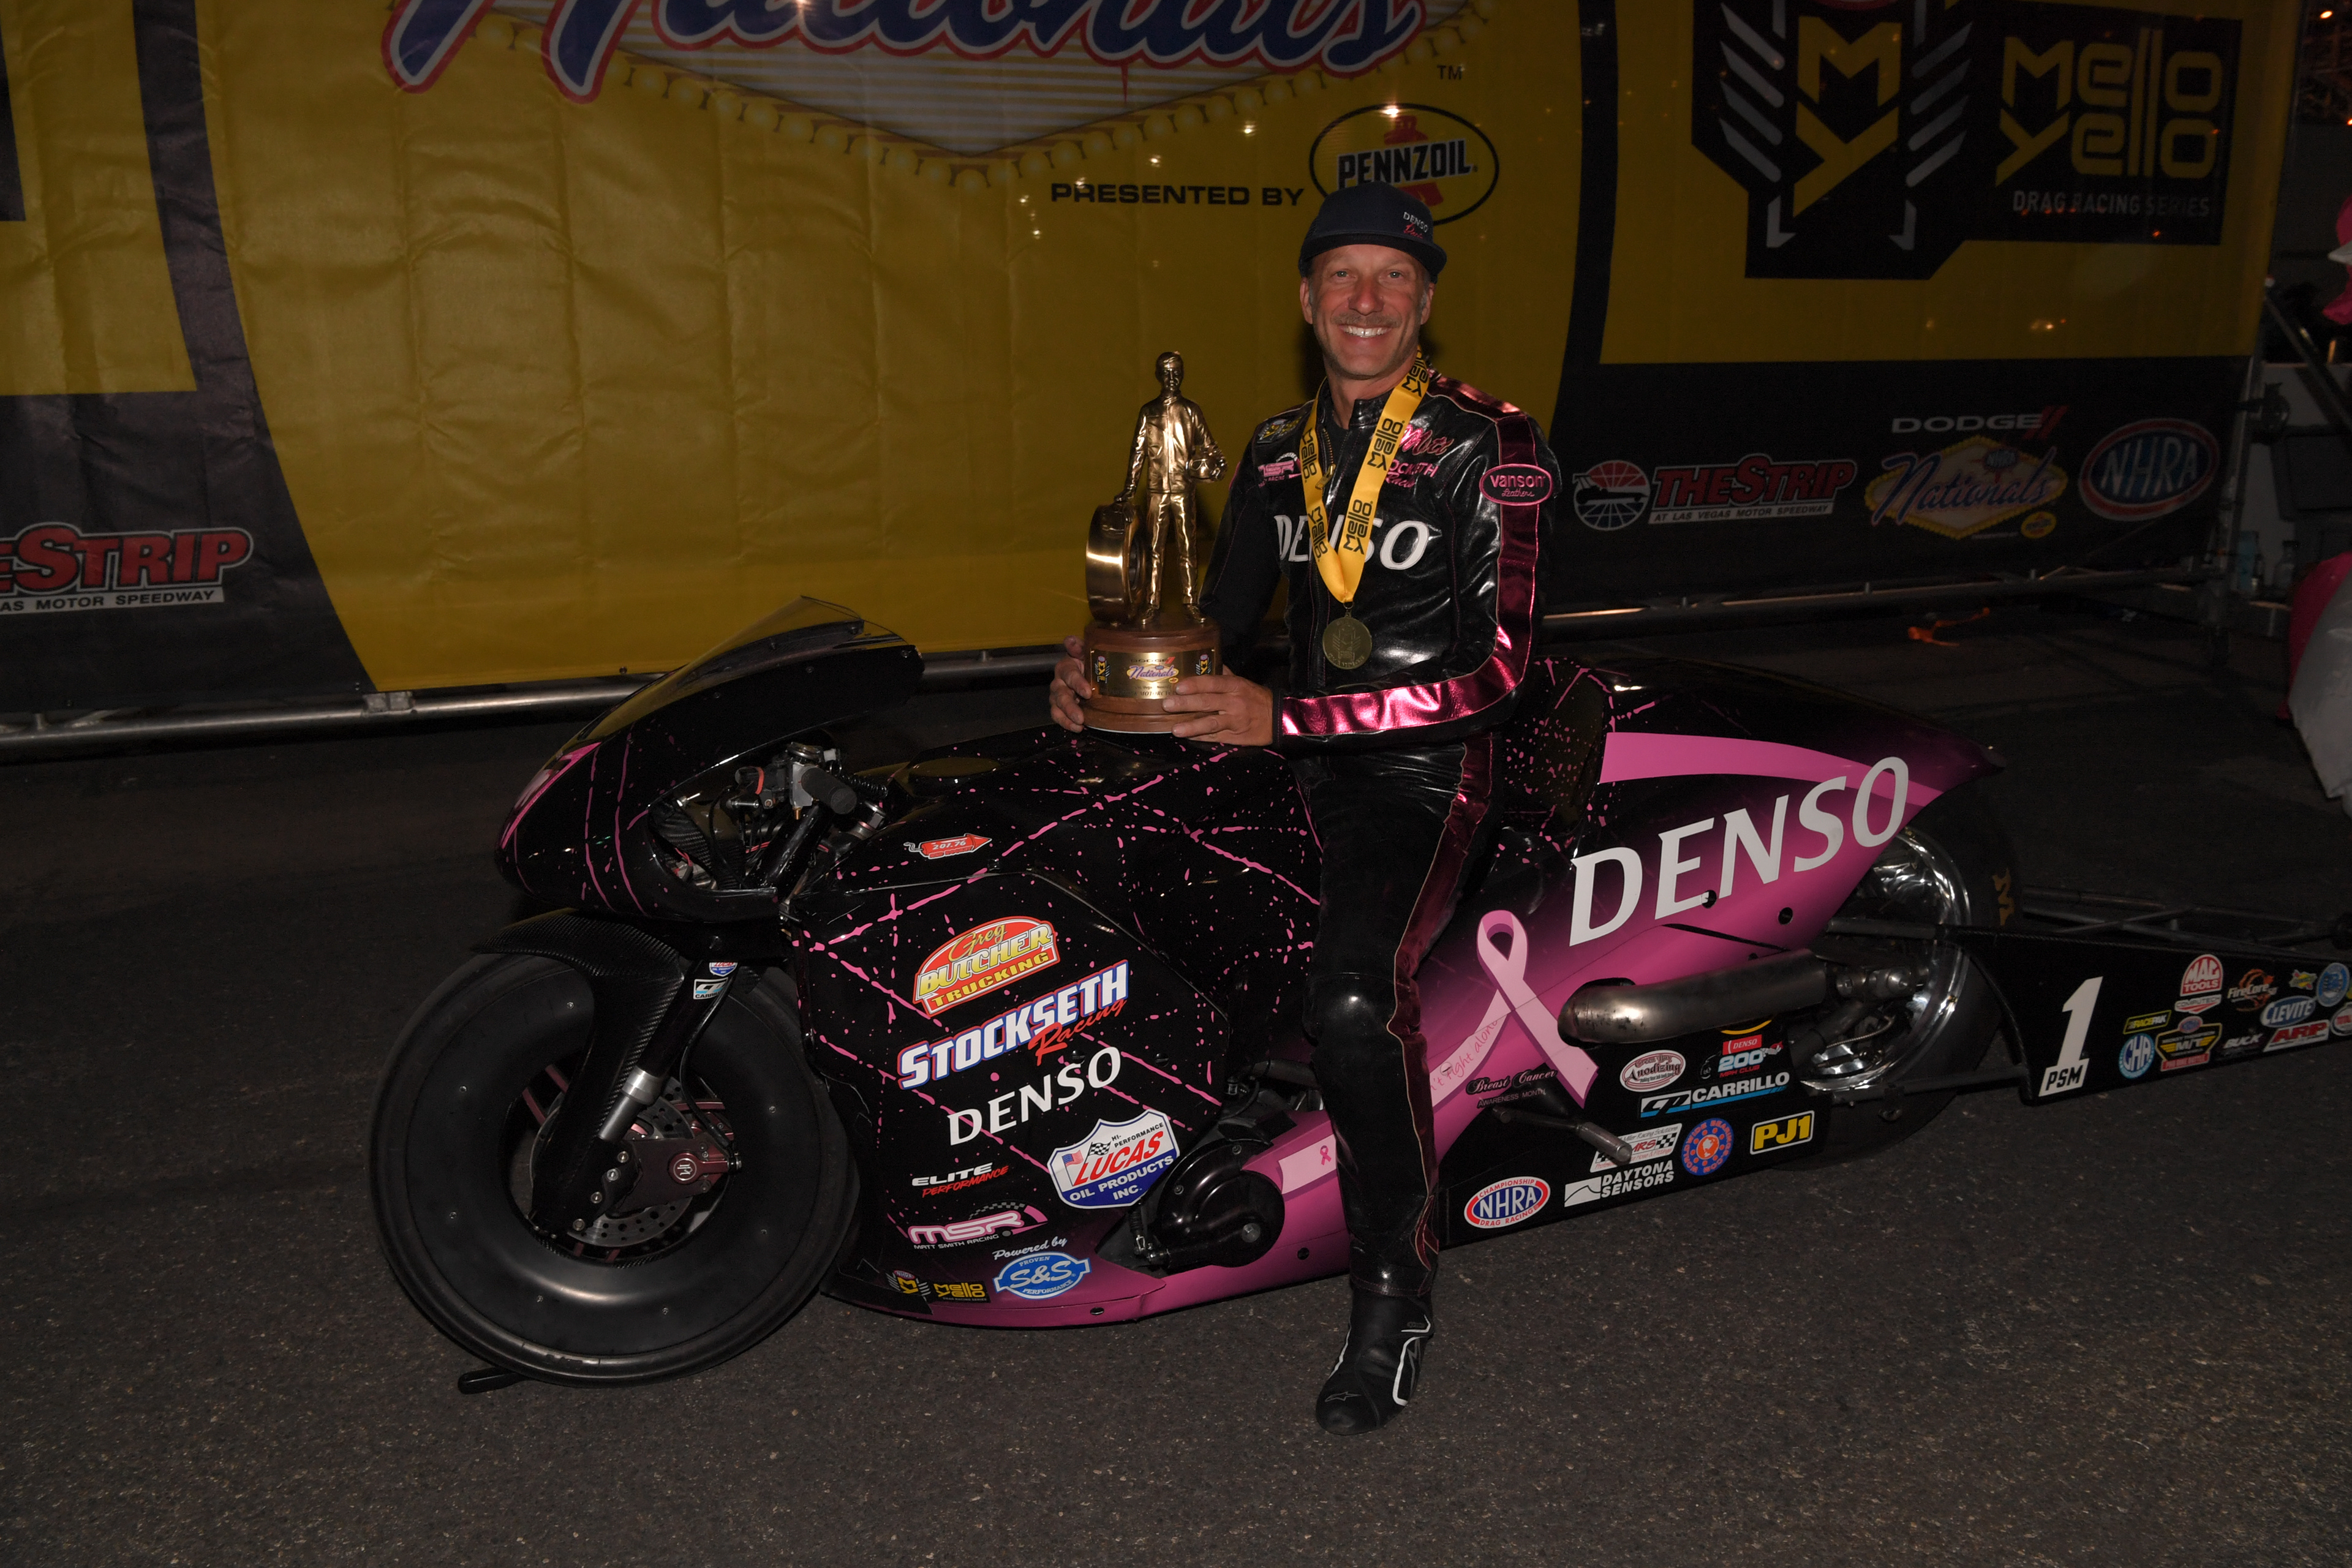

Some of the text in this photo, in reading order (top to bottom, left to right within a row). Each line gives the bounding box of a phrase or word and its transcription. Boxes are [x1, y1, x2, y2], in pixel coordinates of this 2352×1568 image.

[1338, 139, 1472, 190] PENNZOIL
[1051, 183, 1304, 206] PRESENTED BY
[2012, 190, 2211, 217] DRAG RACING SERIES
[1403, 211, 1428, 233] DENSO
[1891, 413, 2043, 434] DODGE
[2100, 437, 2198, 497] NHRA
[1490, 475, 1544, 488] vanson
[1501, 488, 1536, 497] Leathers
[1872, 447, 2057, 526] Nationals
[1654, 504, 1828, 522] AT LAS VEGAS MOTOR SPEEDWAY
[36, 596, 104, 610] MOTOR
[116, 590, 214, 605] SPEEDWAY
[1129, 665, 1175, 679] Nationals
[1569, 756, 1909, 947] DENSO
[948, 924, 1007, 962] Greg
[918, 926, 1052, 997] BUTCHER
[931, 951, 1049, 1008] TRUCKING
[2184, 979, 2218, 992] TOOLS
[900, 961, 1129, 1090] STOCKSETH
[1027, 999, 1128, 1066] Racing
[2057, 976, 2103, 1066] 1
[2272, 1022, 2328, 1043] ARP
[1732, 1038, 1758, 1050] DENSO
[1625, 1062, 1681, 1084] Anodizing
[1717, 1049, 1765, 1073] 200
[1719, 1065, 1761, 1078] MPH CLUB
[1466, 1069, 1558, 1095] Breast Cancer
[1691, 1071, 1790, 1102] CARRILLO
[2045, 1063, 2084, 1090] PSM
[946, 1046, 1121, 1146] DENSO
[1477, 1087, 1547, 1108] AWARENESS MONTH
[1114, 1122, 1164, 1148] PERFORMANCE
[1753, 1115, 1811, 1150] PJ1
[1072, 1131, 1164, 1187] LUCAS
[911, 1162, 993, 1186] ELITE
[921, 1165, 1009, 1199] PERFORMANCE
[1069, 1155, 1174, 1202] OIL PRODUCTS
[1601, 1170, 1675, 1199] SENSORS
[1602, 1159, 1673, 1187] DAYTONA
[1479, 1178, 1535, 1198] CHAMPIONSHIP
[1479, 1186, 1537, 1218] NHRA
[908, 1210, 1025, 1244] MSR
[1505, 1208, 1534, 1224] RACING
[967, 1234, 1000, 1245] RACING
[991, 1235, 1068, 1261] Powered by
[1009, 1260, 1072, 1289] S&S
[1019, 1256, 1051, 1267] PROVEN
[1022, 1279, 1074, 1295] PERFORMANCE
